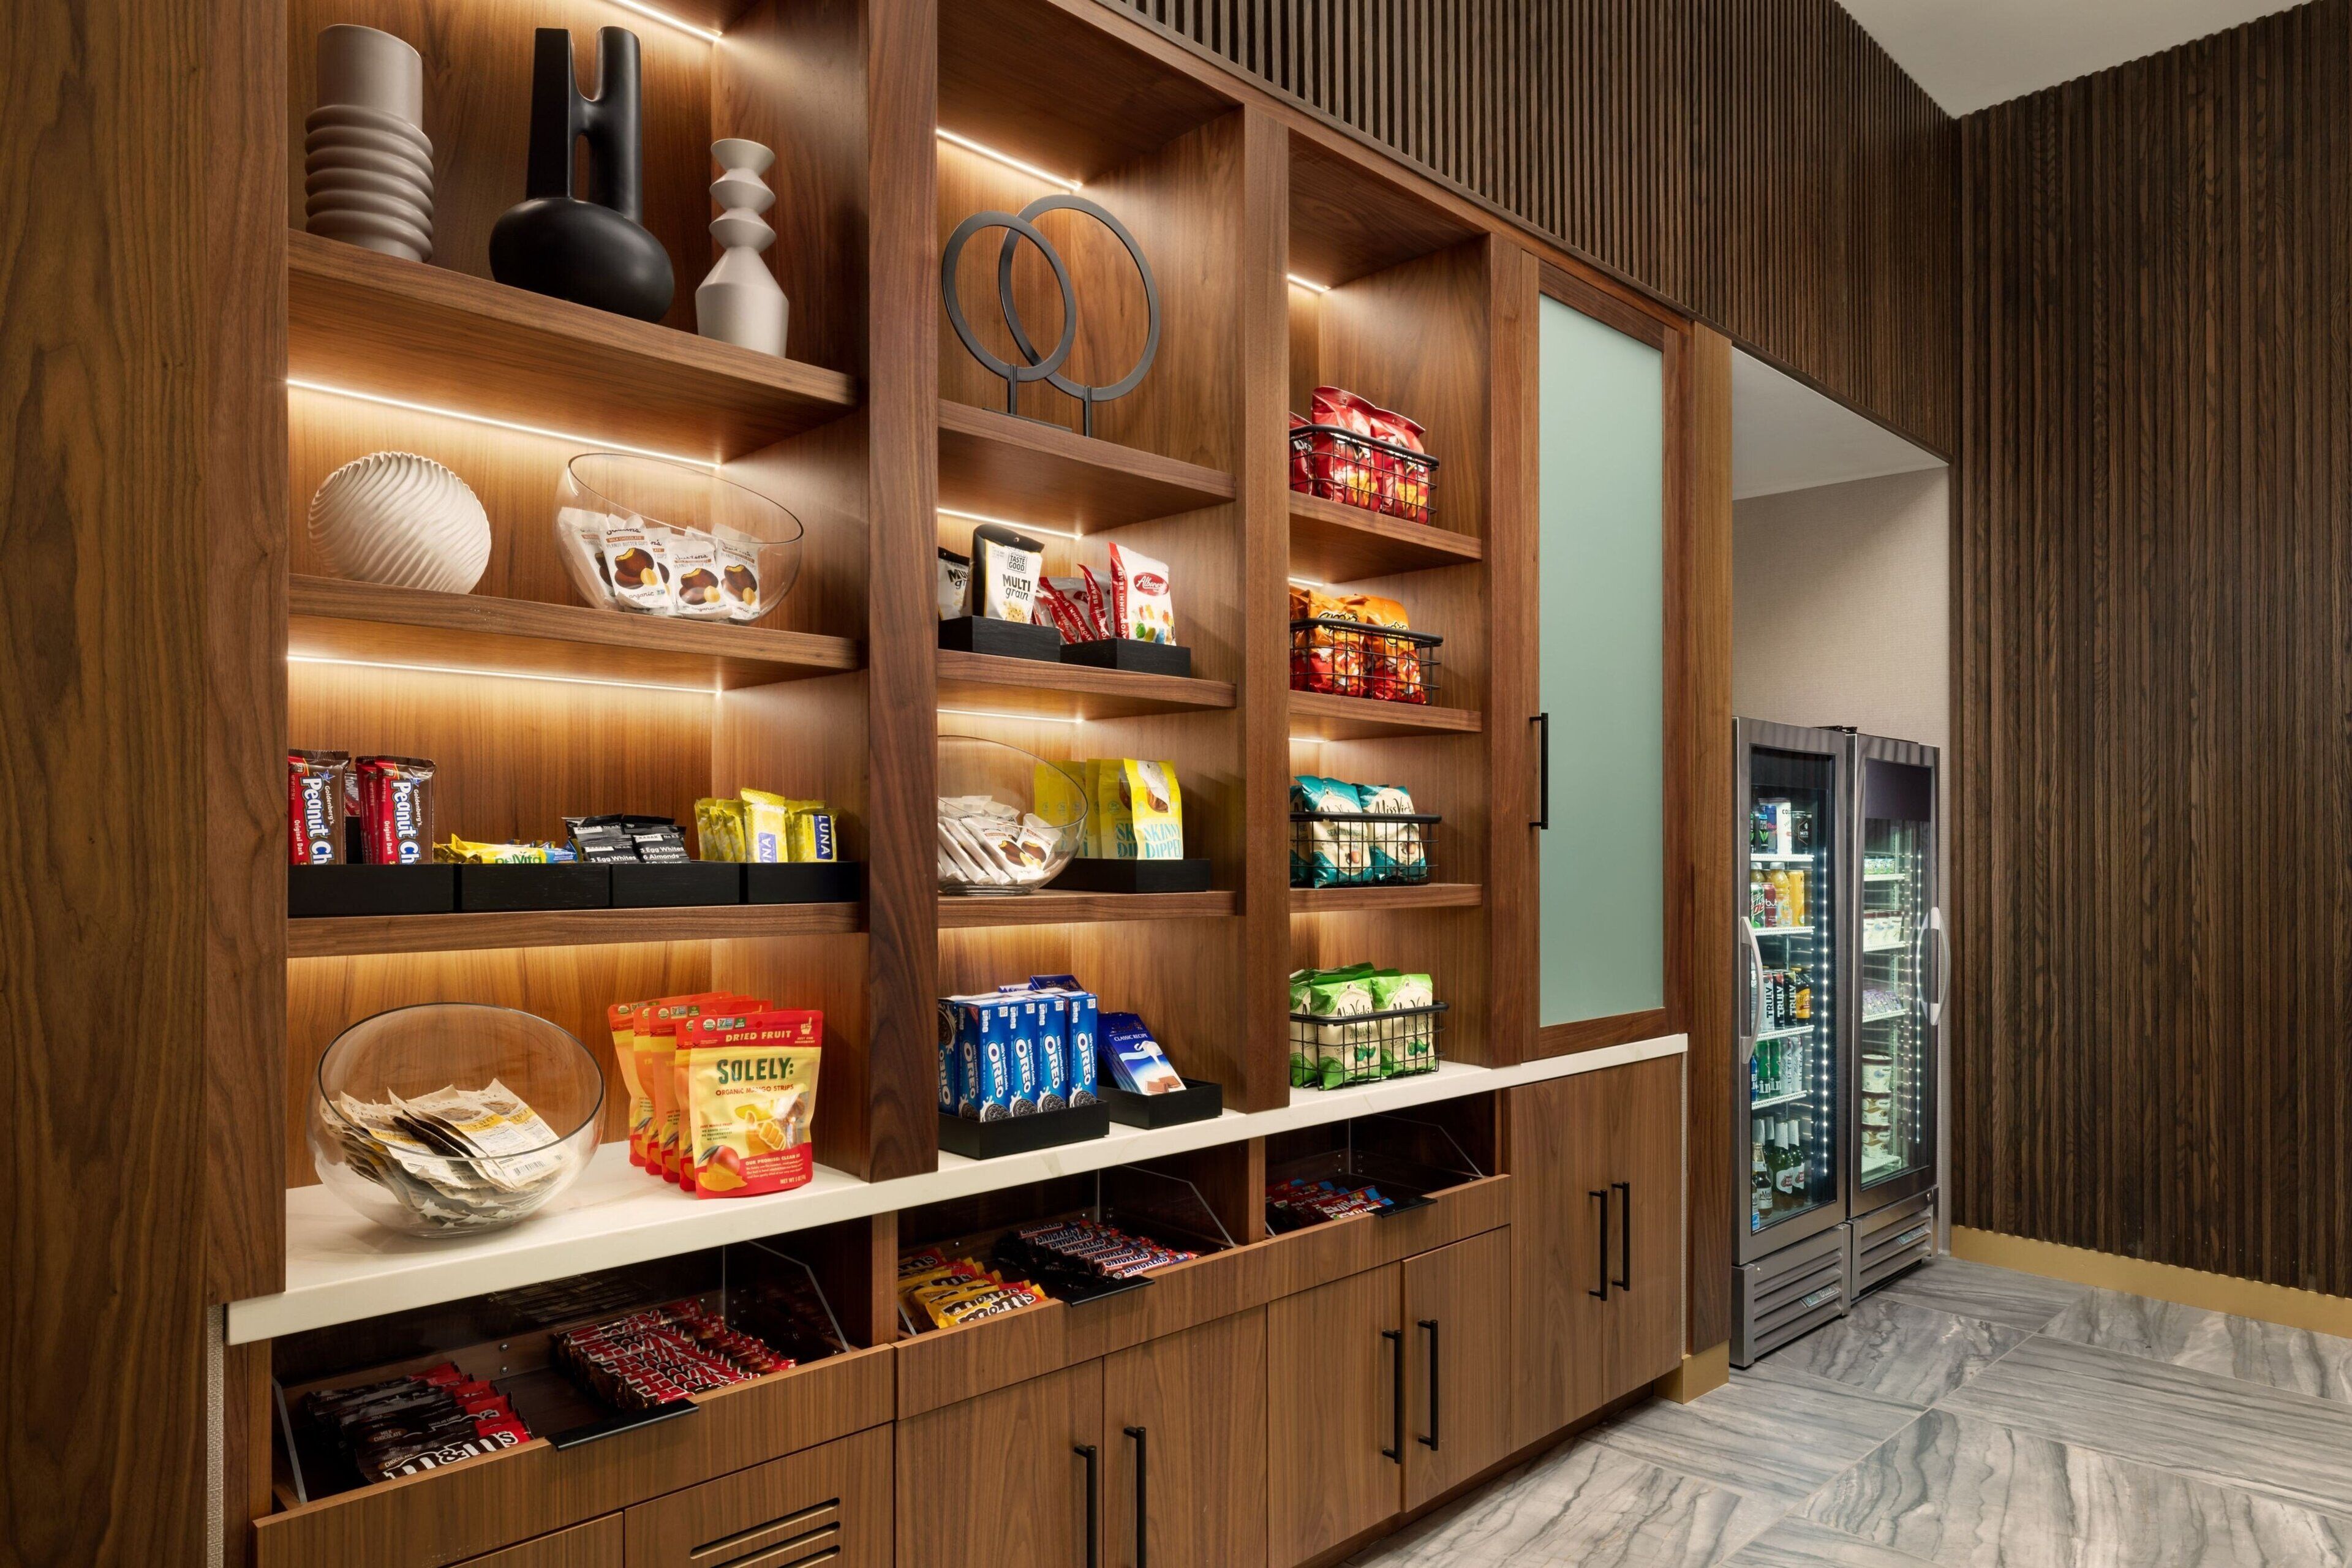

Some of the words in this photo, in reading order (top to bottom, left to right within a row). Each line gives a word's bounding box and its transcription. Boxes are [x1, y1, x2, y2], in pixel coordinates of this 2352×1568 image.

[1008, 562, 1025, 571] GOOD
[1010, 555, 1025, 565] TASTE
[1002, 573, 1031, 592] MULTI
[1005, 587, 1029, 601] grain
[301, 778, 329, 838] Peanut
[325, 785, 335, 825] Goldenberg's
[392, 781, 418, 838] Peanut
[413, 789, 423, 826] Goldenberg's
[294, 820, 303, 842] Original
[818, 815, 831, 855] LUNA
[725, 1032, 757, 1042] DRIED
[761, 1030, 792, 1039] FRUIT
[987, 1042, 1004, 1098] OREO
[1016, 1038, 1031, 1093] OREO
[1044, 1035, 1060, 1089] OREO
[1077, 1033, 1091, 1085] OREO
[939, 1049, 951, 1105] OREO
[963, 1042, 976, 1099] OREO
[715, 1088, 744, 1096] ORGANIC
[1036, 1227, 1080, 1243] SNICKERS
[1105, 1253, 1150, 1267] SNICKERS
[1125, 1257, 1169, 1274] SNICKERS
[373, 1430, 402, 1442] CHOCOLATE
[384, 1452, 415, 1468] CHOCOLATE
